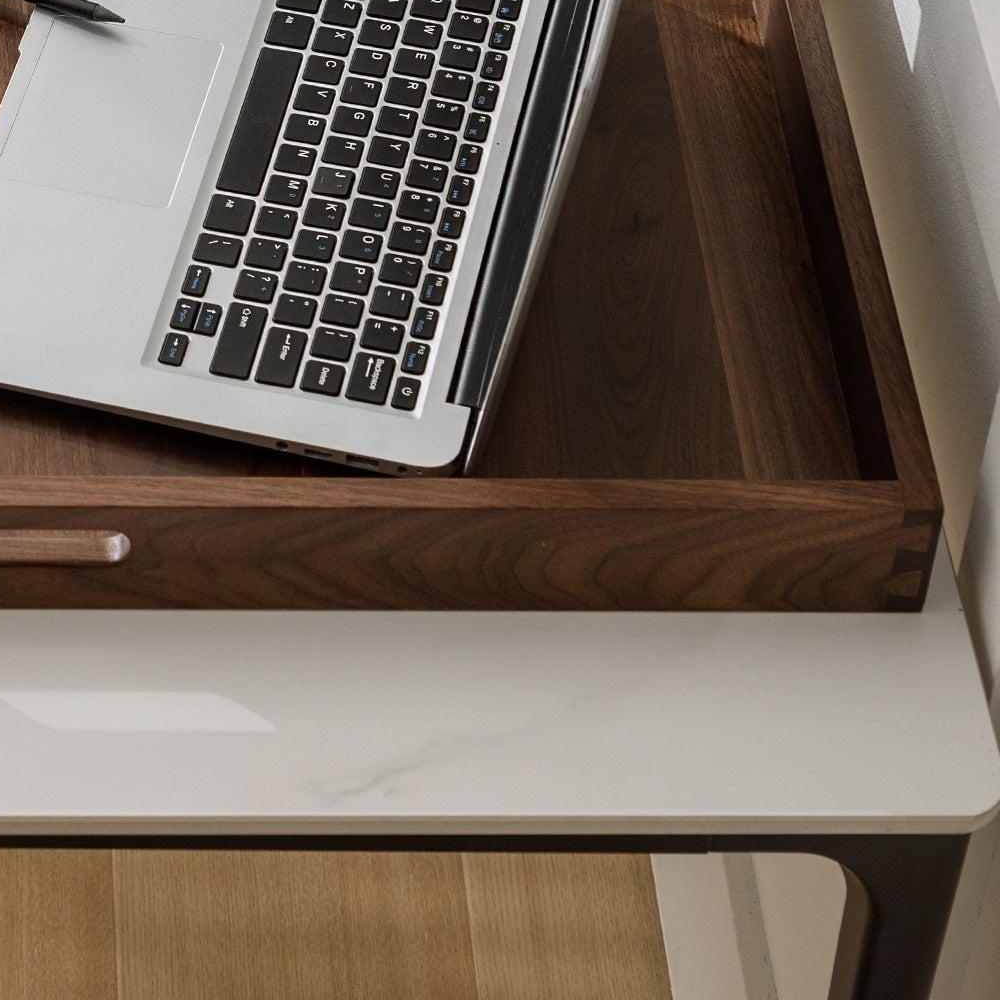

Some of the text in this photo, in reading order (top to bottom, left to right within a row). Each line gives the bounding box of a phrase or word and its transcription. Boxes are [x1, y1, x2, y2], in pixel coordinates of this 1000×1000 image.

[380, 23, 391, 31] S
[424, 25, 435, 34] W
[407, 82, 419, 90] R
[354, 112, 365, 120] G
[345, 142, 357, 150] H
[297, 149, 310, 158] N
[381, 173, 393, 181] U
[288, 180, 300, 190] M
[325, 203, 338, 212] K
[363, 236, 375, 244] O
[355, 267, 366, 275] P
[240, 316, 249, 328] Shift
[280, 345, 290, 361] Enter
[418, 345, 426, 355] F12
[319, 367, 330, 386] Delete
[369, 358, 385, 391] Backspace
